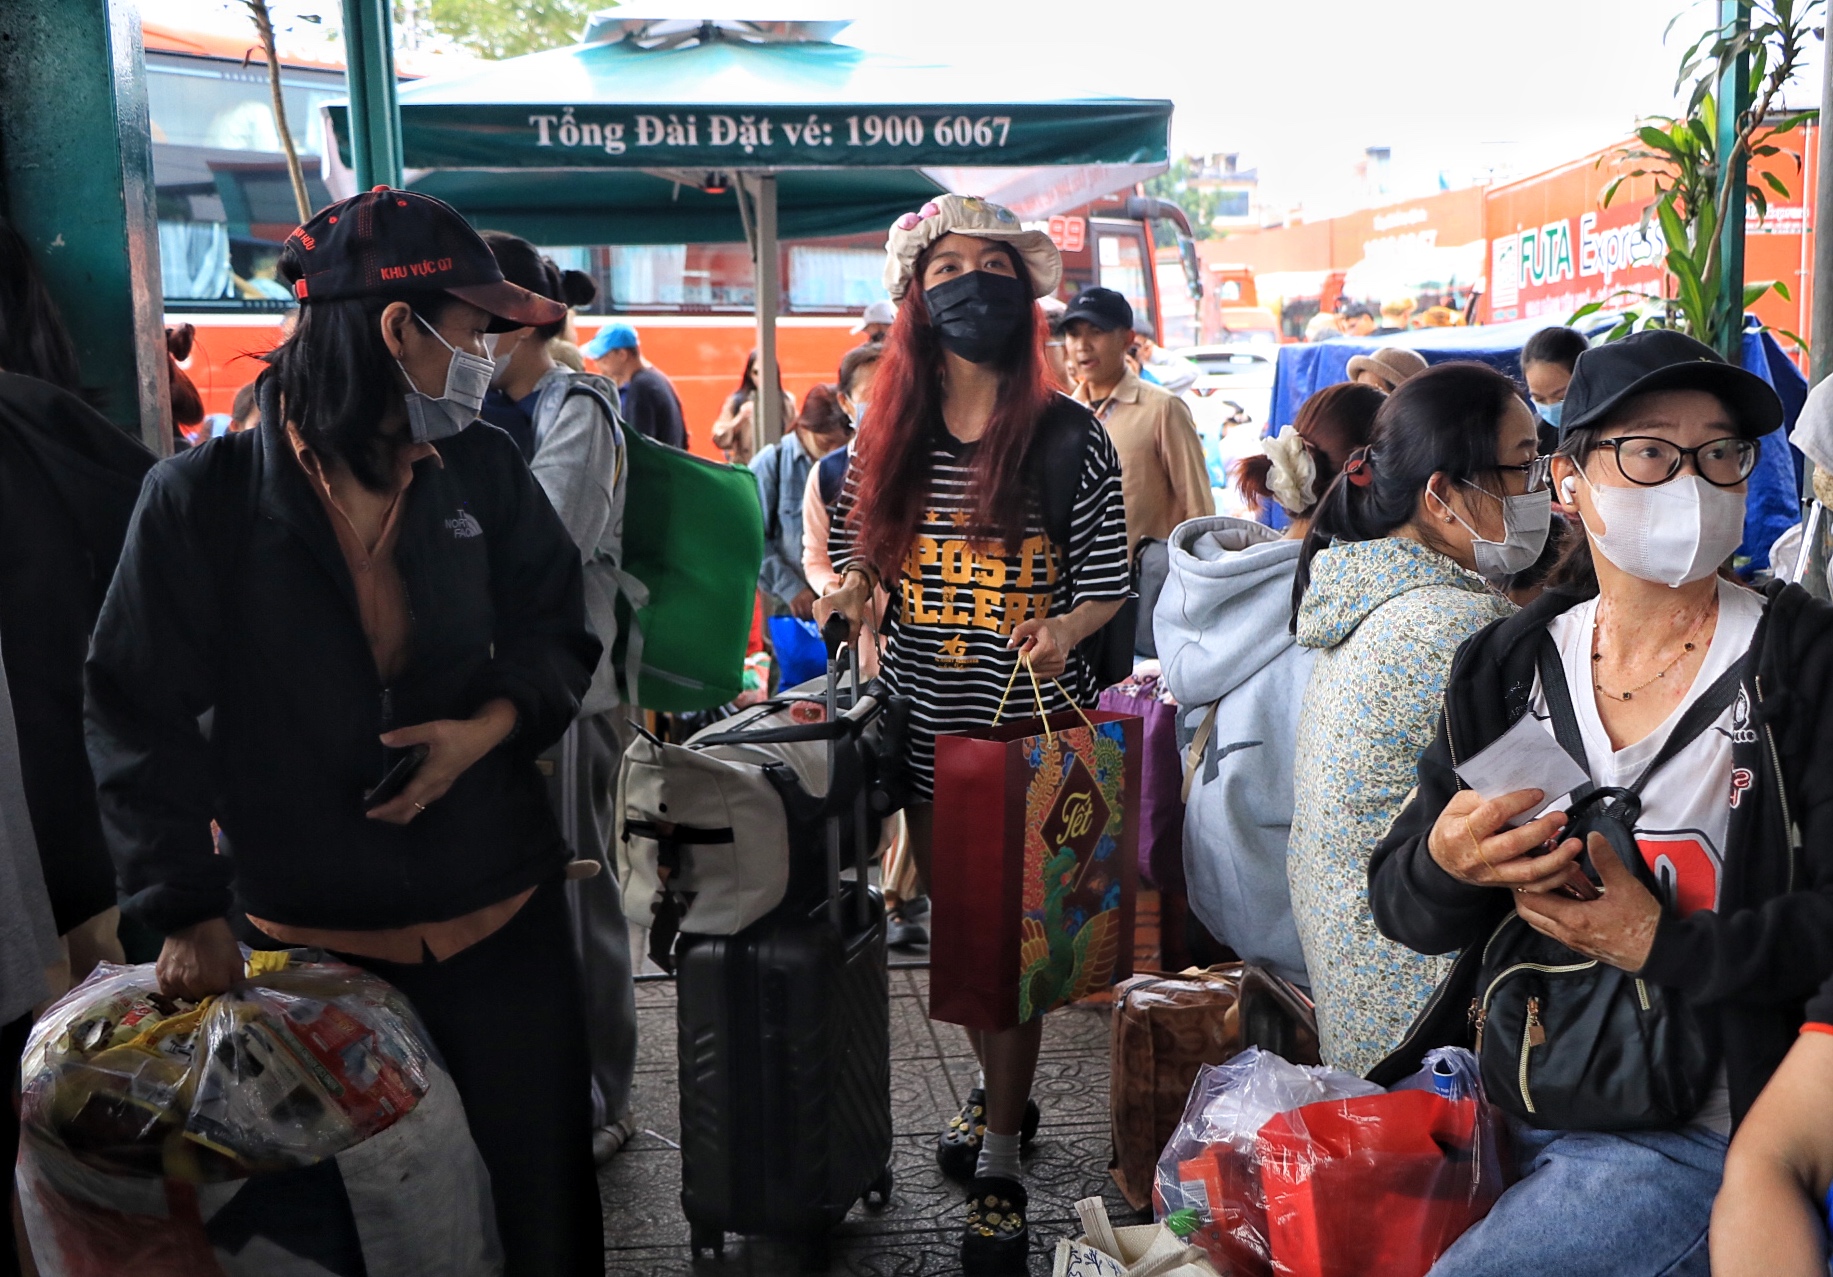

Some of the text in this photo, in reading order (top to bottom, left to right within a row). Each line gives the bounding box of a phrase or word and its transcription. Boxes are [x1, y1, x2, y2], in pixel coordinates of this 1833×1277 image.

[529, 106, 1012, 155] Tổng Đài Đặt vé: 1900 6067
[381, 267, 408, 281] KHU
[410, 259, 437, 277] VỰC
[1520, 216, 1666, 285] FUTA Express
[1056, 789, 1094, 845] Tết
